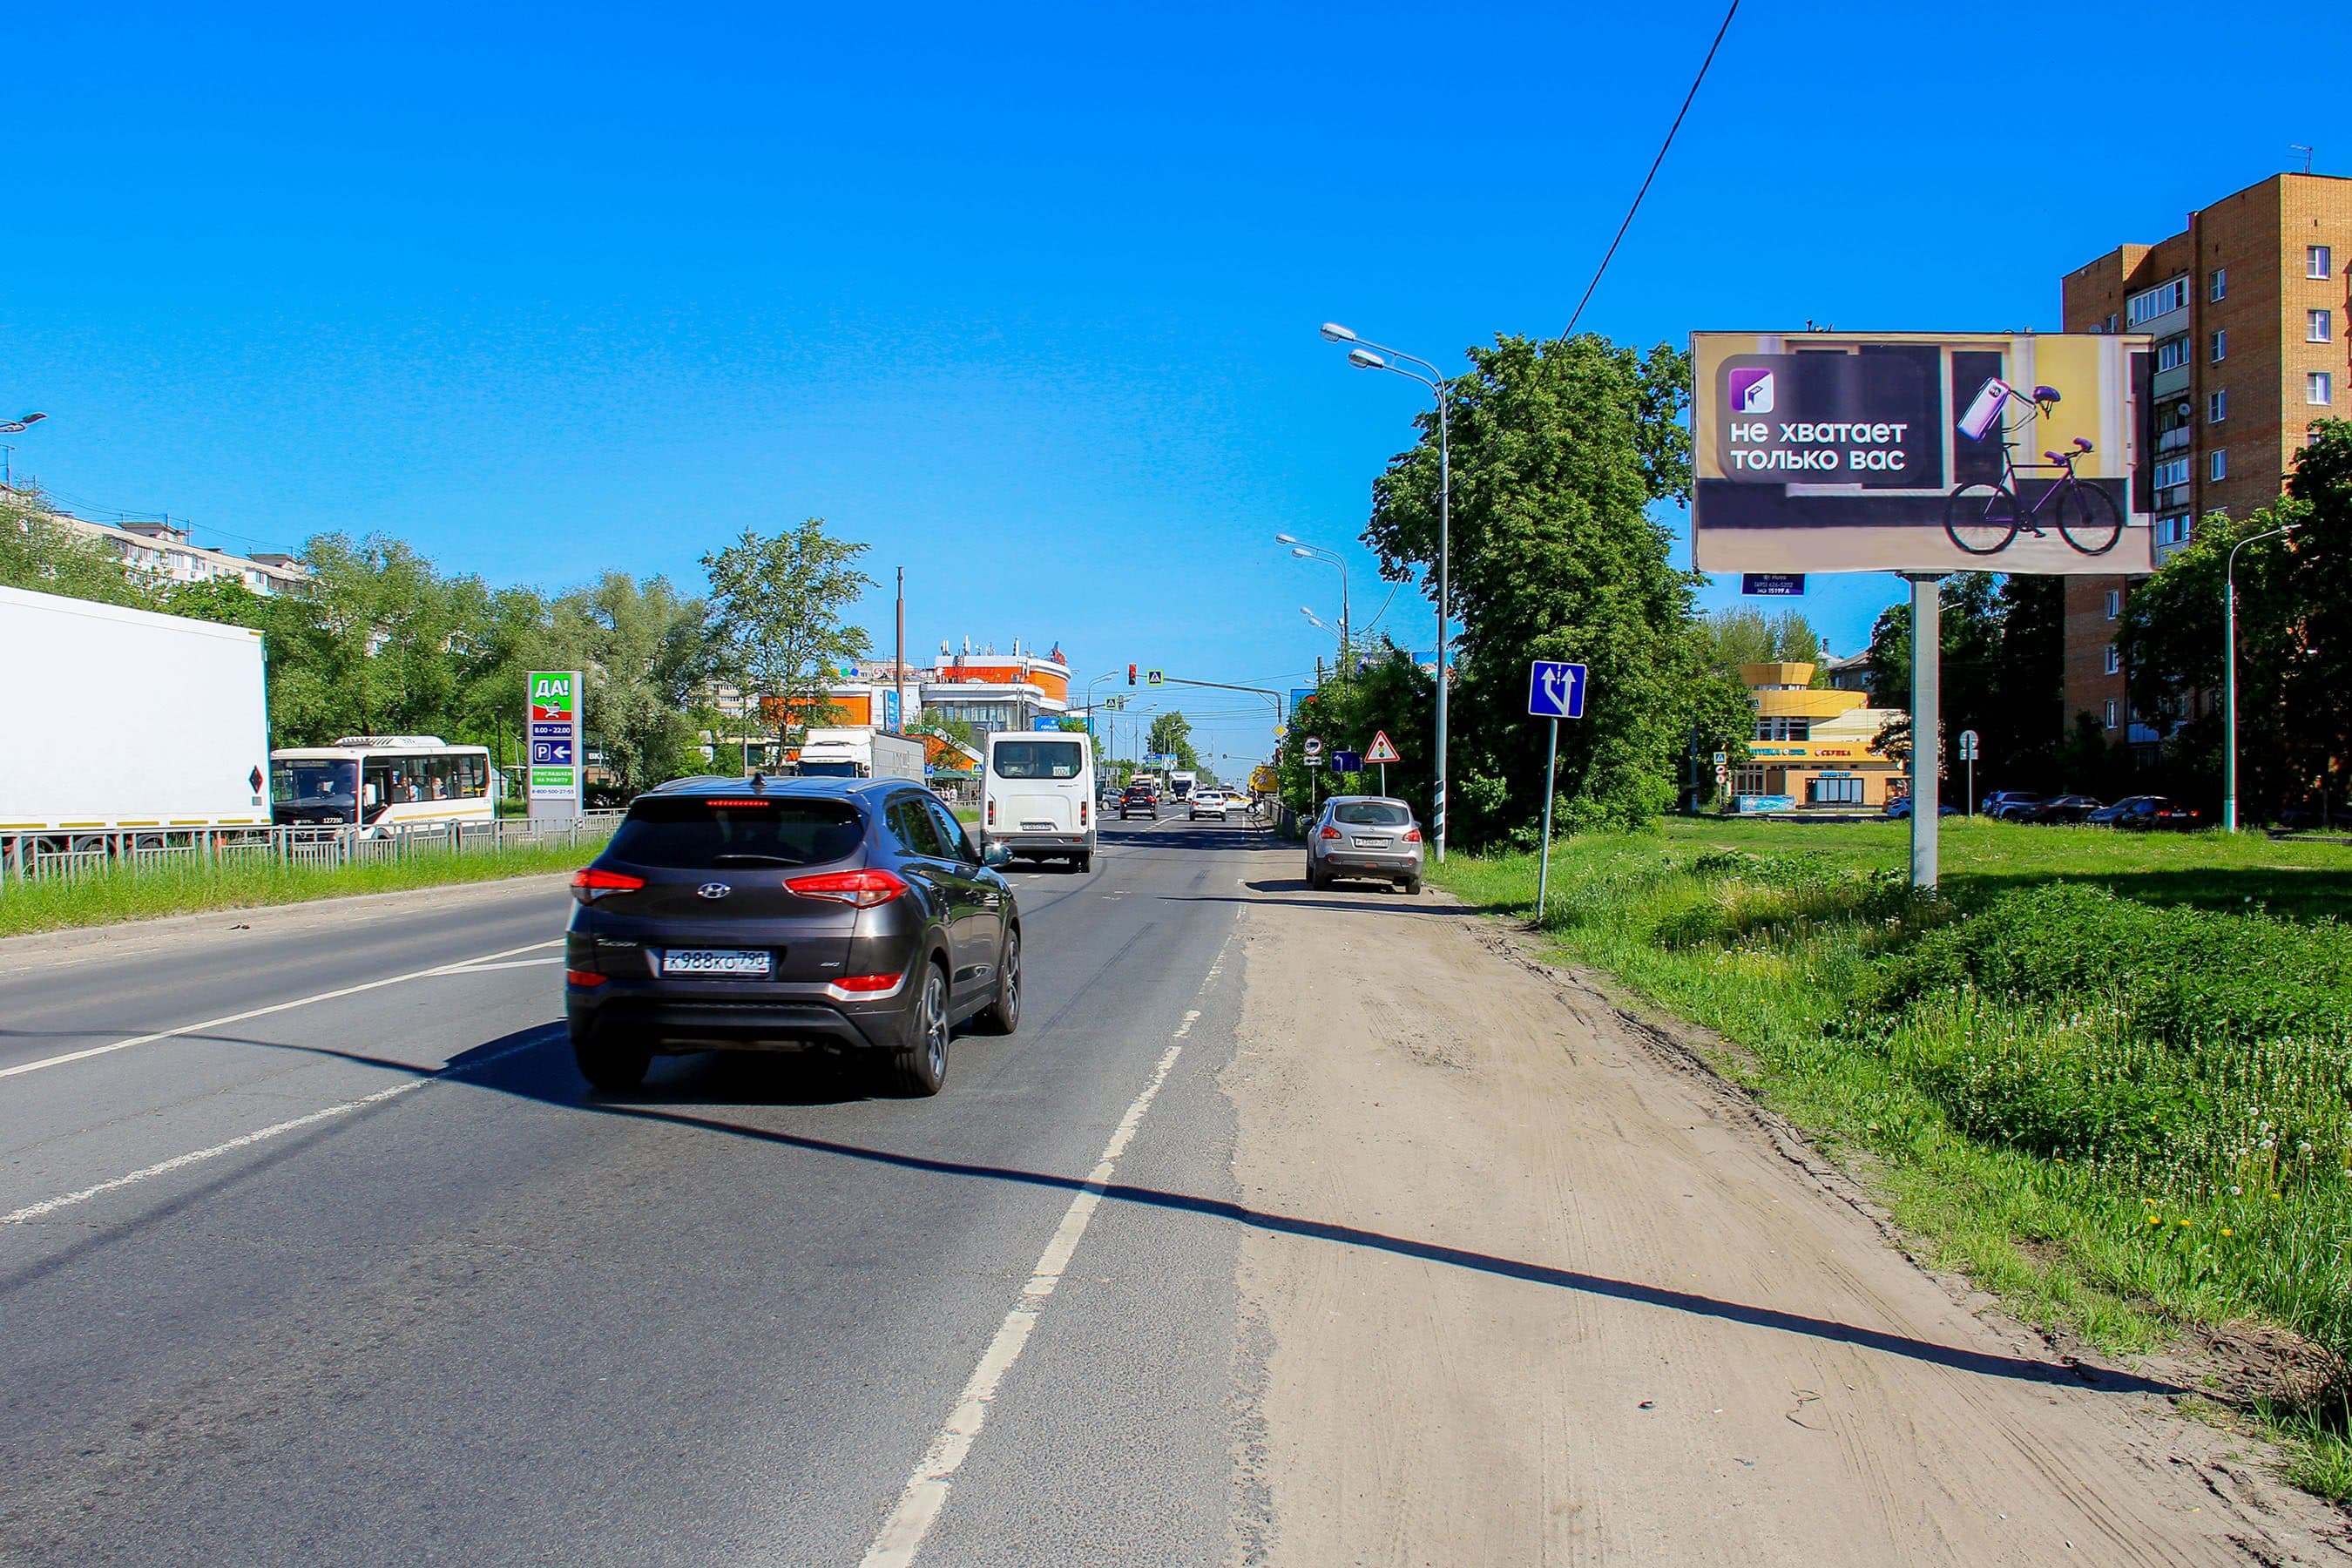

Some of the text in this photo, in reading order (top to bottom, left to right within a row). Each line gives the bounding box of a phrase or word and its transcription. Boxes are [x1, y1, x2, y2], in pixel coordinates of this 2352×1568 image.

[1730, 422, 1908, 443] не хватает
[1730, 449, 1906, 470] только вас
[535, 679, 569, 698] ДА!
